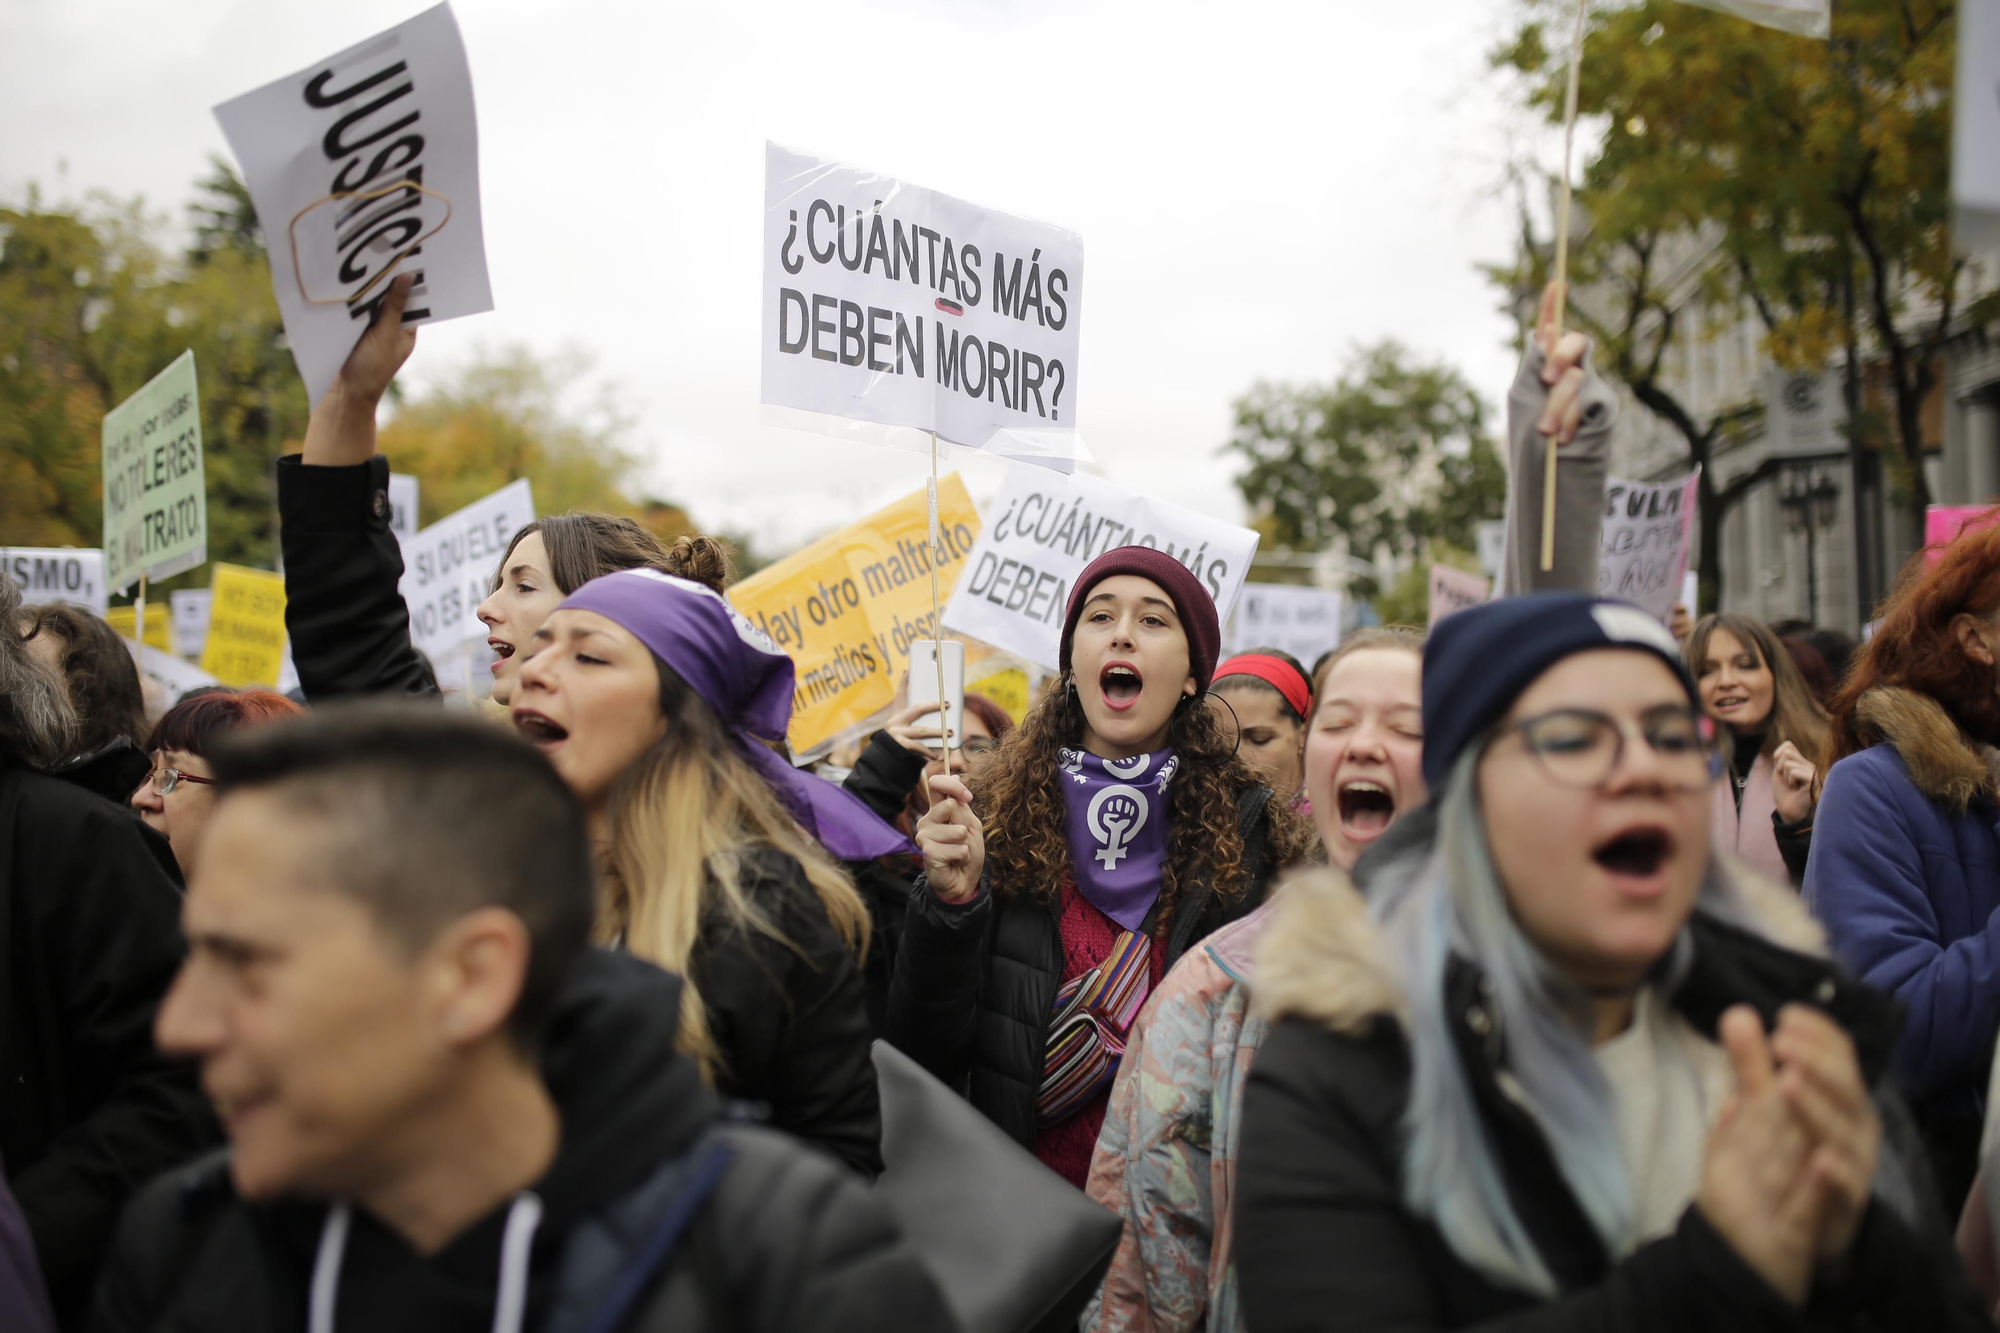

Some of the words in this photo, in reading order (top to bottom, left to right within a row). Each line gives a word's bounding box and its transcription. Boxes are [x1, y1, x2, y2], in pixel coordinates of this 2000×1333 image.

[781, 199, 982, 307] ¿CUÁNTAS
[993, 248, 1068, 331] MÁS
[779, 287, 924, 378] DEBEN
[936, 321, 1065, 421] MORIR?
[127, 427, 197, 498] TOLERES
[416, 548, 436, 587] SI
[439, 513, 510, 575] DUELE
[806, 577, 859, 627] otro
[862, 523, 974, 598] maltrato
[412, 603, 437, 639] NO
[441, 586, 462, 628] ES
[967, 551, 1066, 630] DEBEN
[804, 643, 876, 705] medios
[873, 631, 894, 676] y
